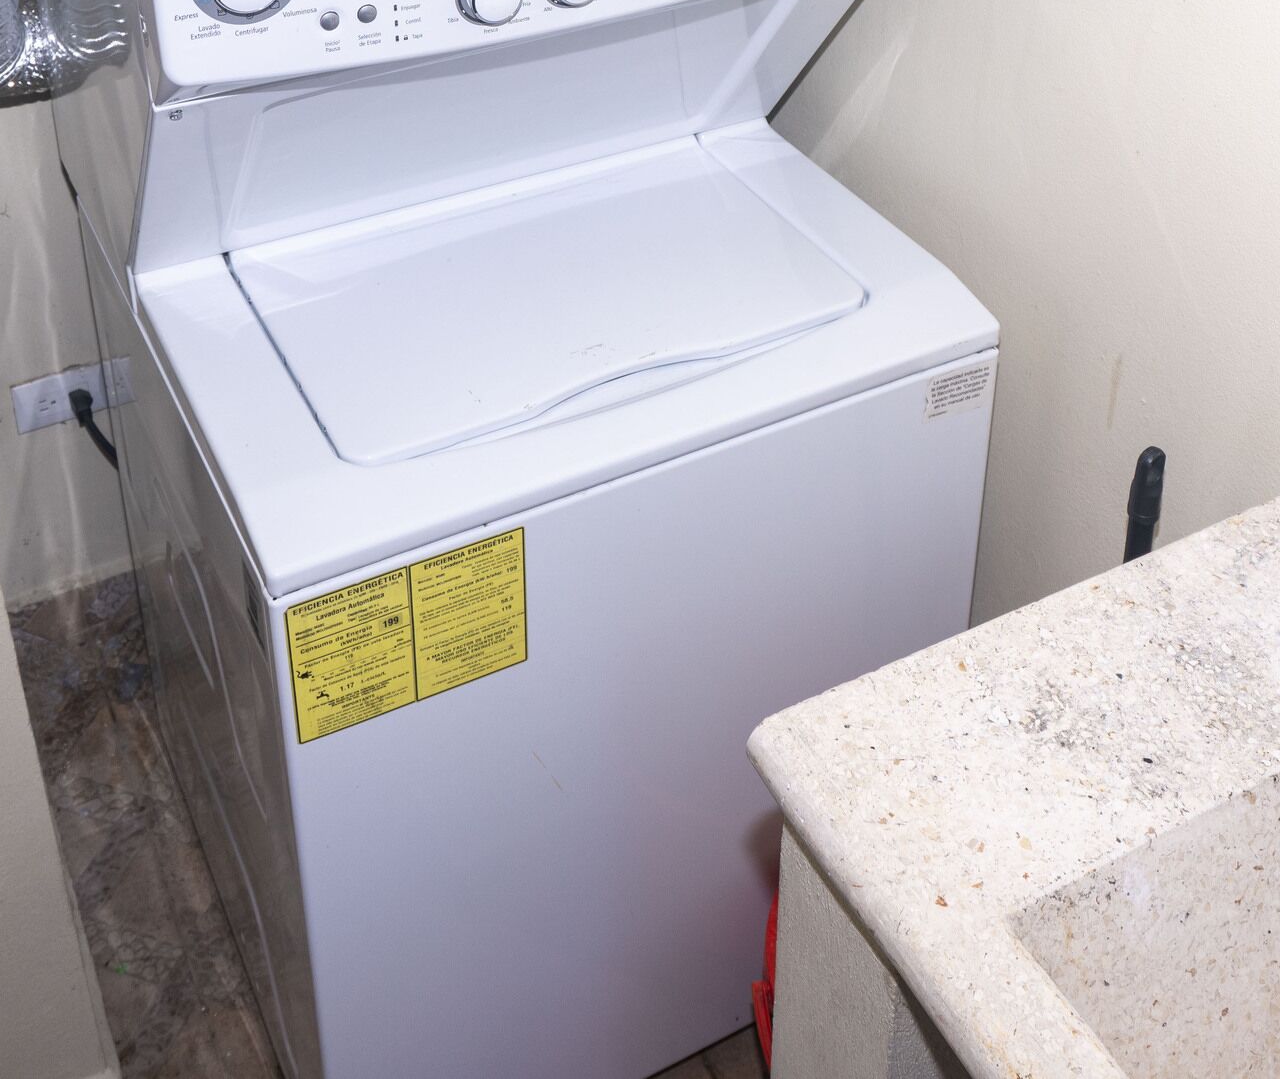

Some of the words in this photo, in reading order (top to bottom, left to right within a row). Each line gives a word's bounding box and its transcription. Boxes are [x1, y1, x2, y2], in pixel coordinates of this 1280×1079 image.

[174, 12, 199, 22] Express
[282, 6, 318, 18] Voluminosa
[198, 24, 220, 32] Lavado
[190, 30, 222, 40] Extendido
[424, 552, 465, 570] EFICIENCIA
[468, 534, 514, 556] ENERGÉTICA
[292, 594, 344, 616] EFICIENCIA
[348, 572, 404, 596] ENERGÉTICA
[316, 607, 346, 622] Lavadora
[348, 592, 385, 610] Automática
[300, 640, 333, 654] Consumo
[383, 616, 399, 628] 199
[432, 648, 452, 660] MAYOR
[452, 640, 474, 652] FACTOR
[442, 650, 470, 664] RECURSOS
[304, 660, 320, 668] Factor
[340, 682, 354, 692] 1.17
